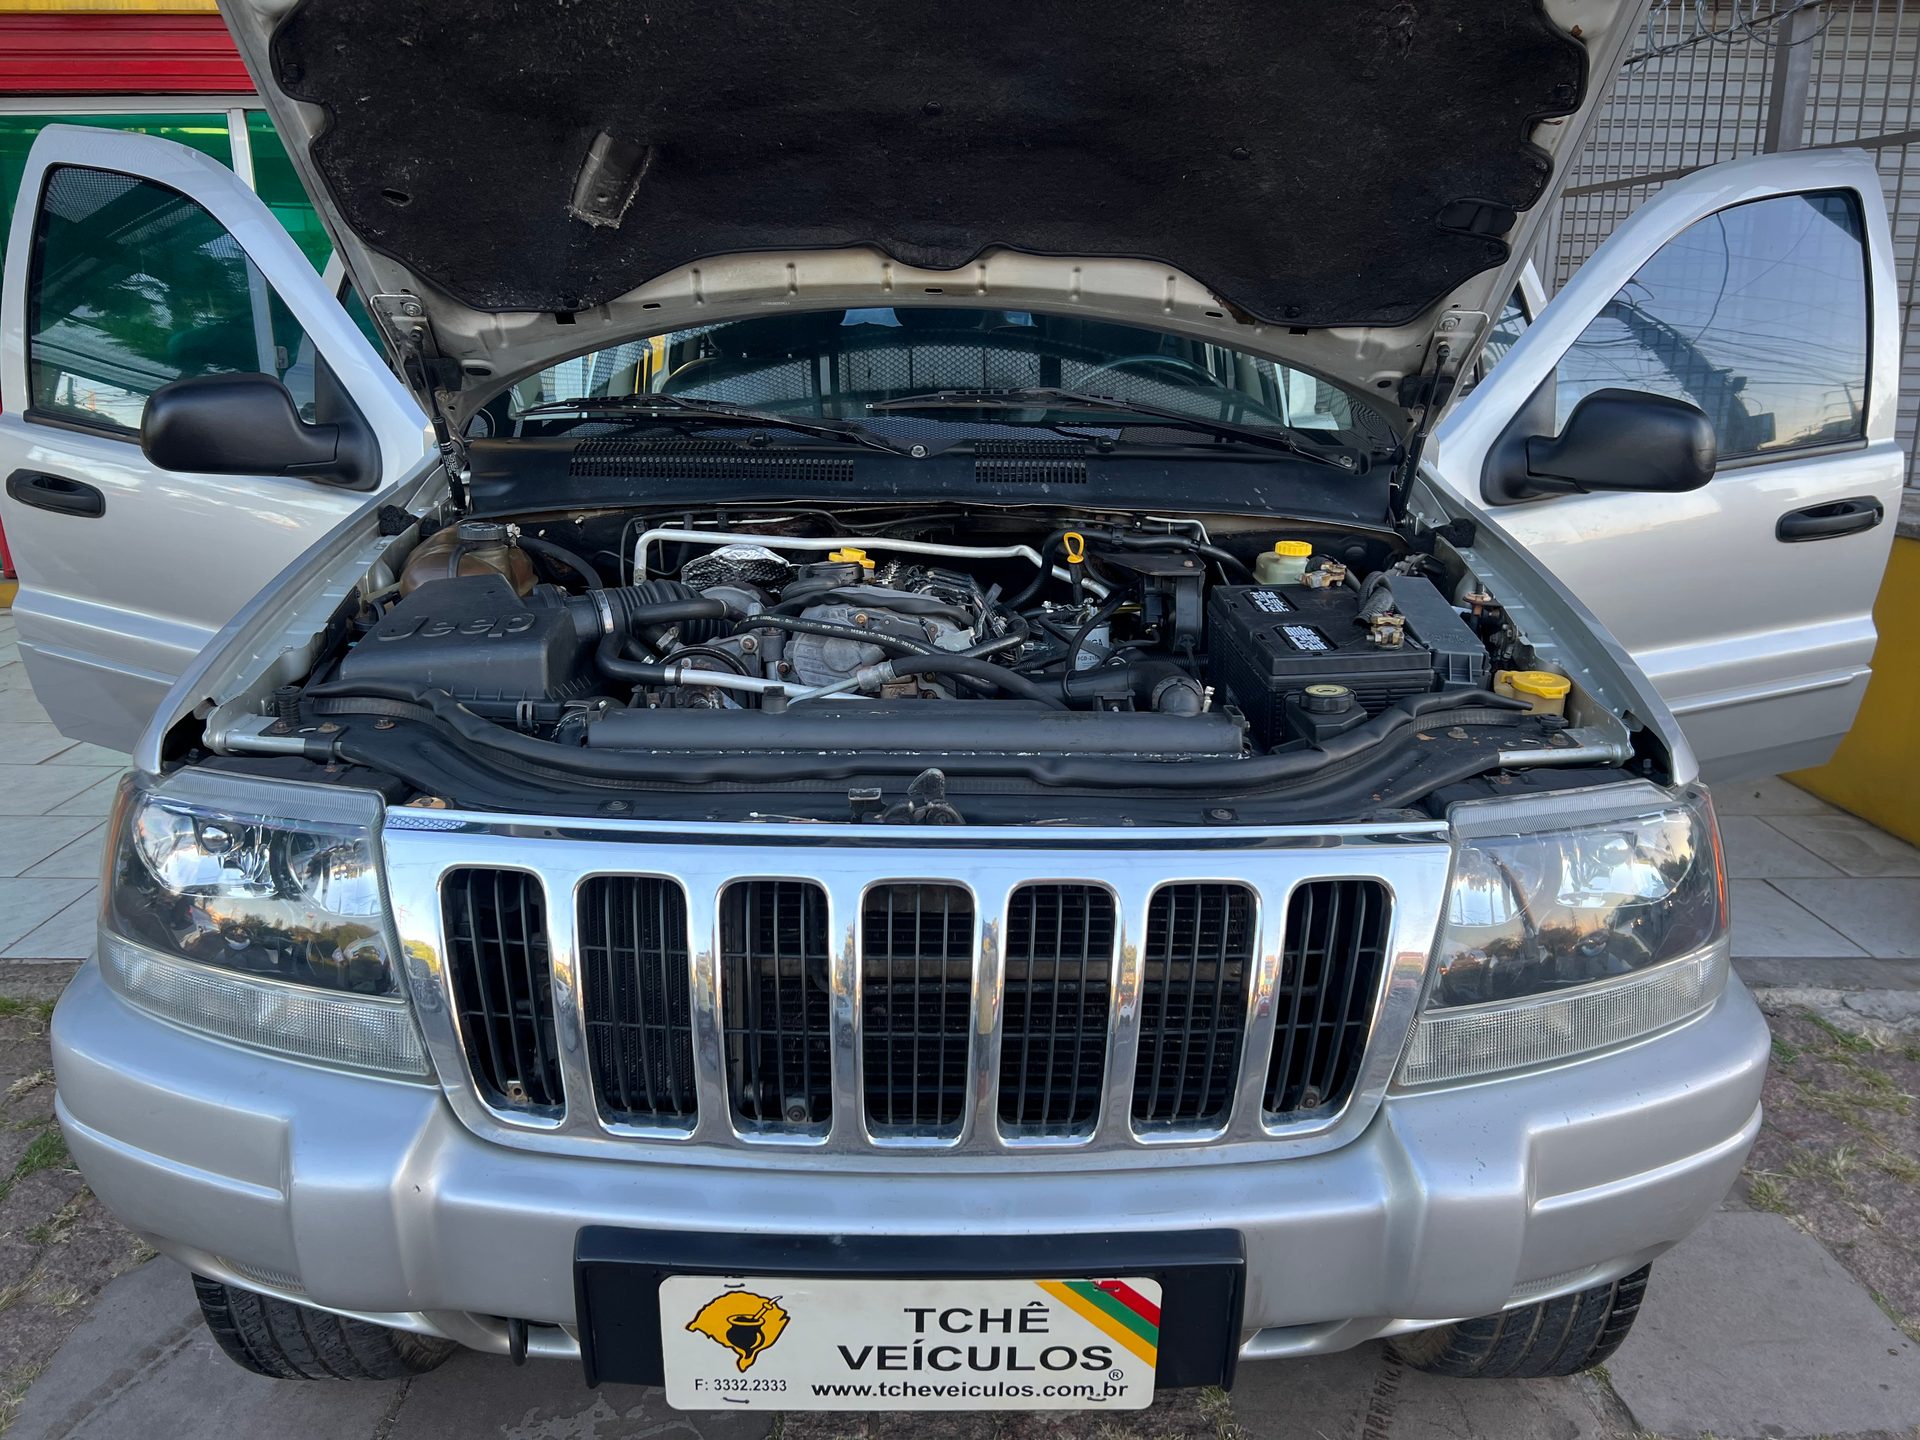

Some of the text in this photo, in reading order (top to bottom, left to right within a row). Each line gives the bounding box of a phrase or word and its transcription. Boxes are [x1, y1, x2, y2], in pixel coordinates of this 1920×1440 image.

[376, 613, 535, 642] Jeep
[904, 1301, 1050, 1334] TCHÊ
[837, 1338, 1113, 1372] VEÍCULOS
[694, 1378, 788, 1392] F: 3332.2333
[811, 1381, 1129, 1398] www.tcheveiculos.com.br
